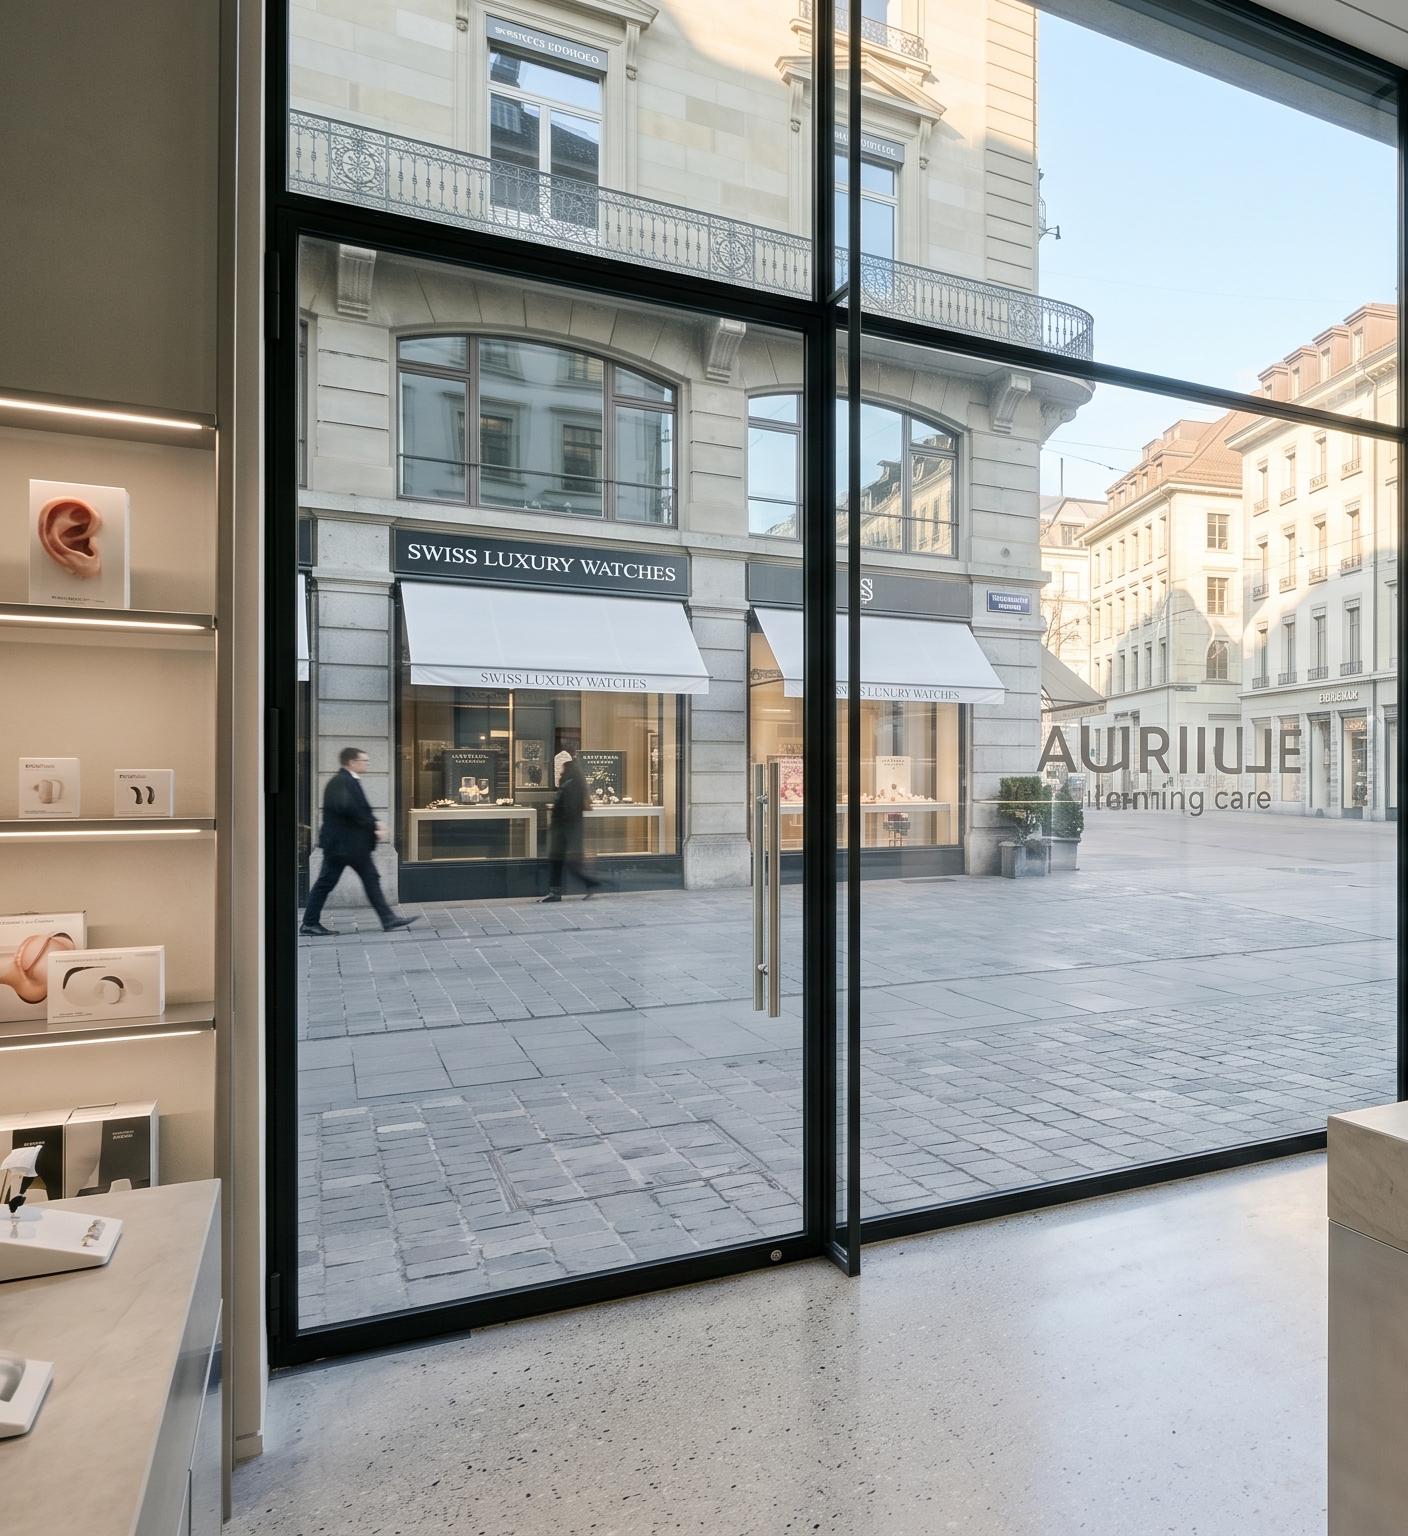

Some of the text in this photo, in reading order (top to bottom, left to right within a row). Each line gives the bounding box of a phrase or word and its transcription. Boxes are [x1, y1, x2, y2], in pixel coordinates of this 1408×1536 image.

[407, 543, 677, 582] SWISS LUXURY WATCHES
[481, 672, 522, 685] SWISS
[525, 674, 583, 687] LUXURY
[1214, 790, 1272, 810] care
